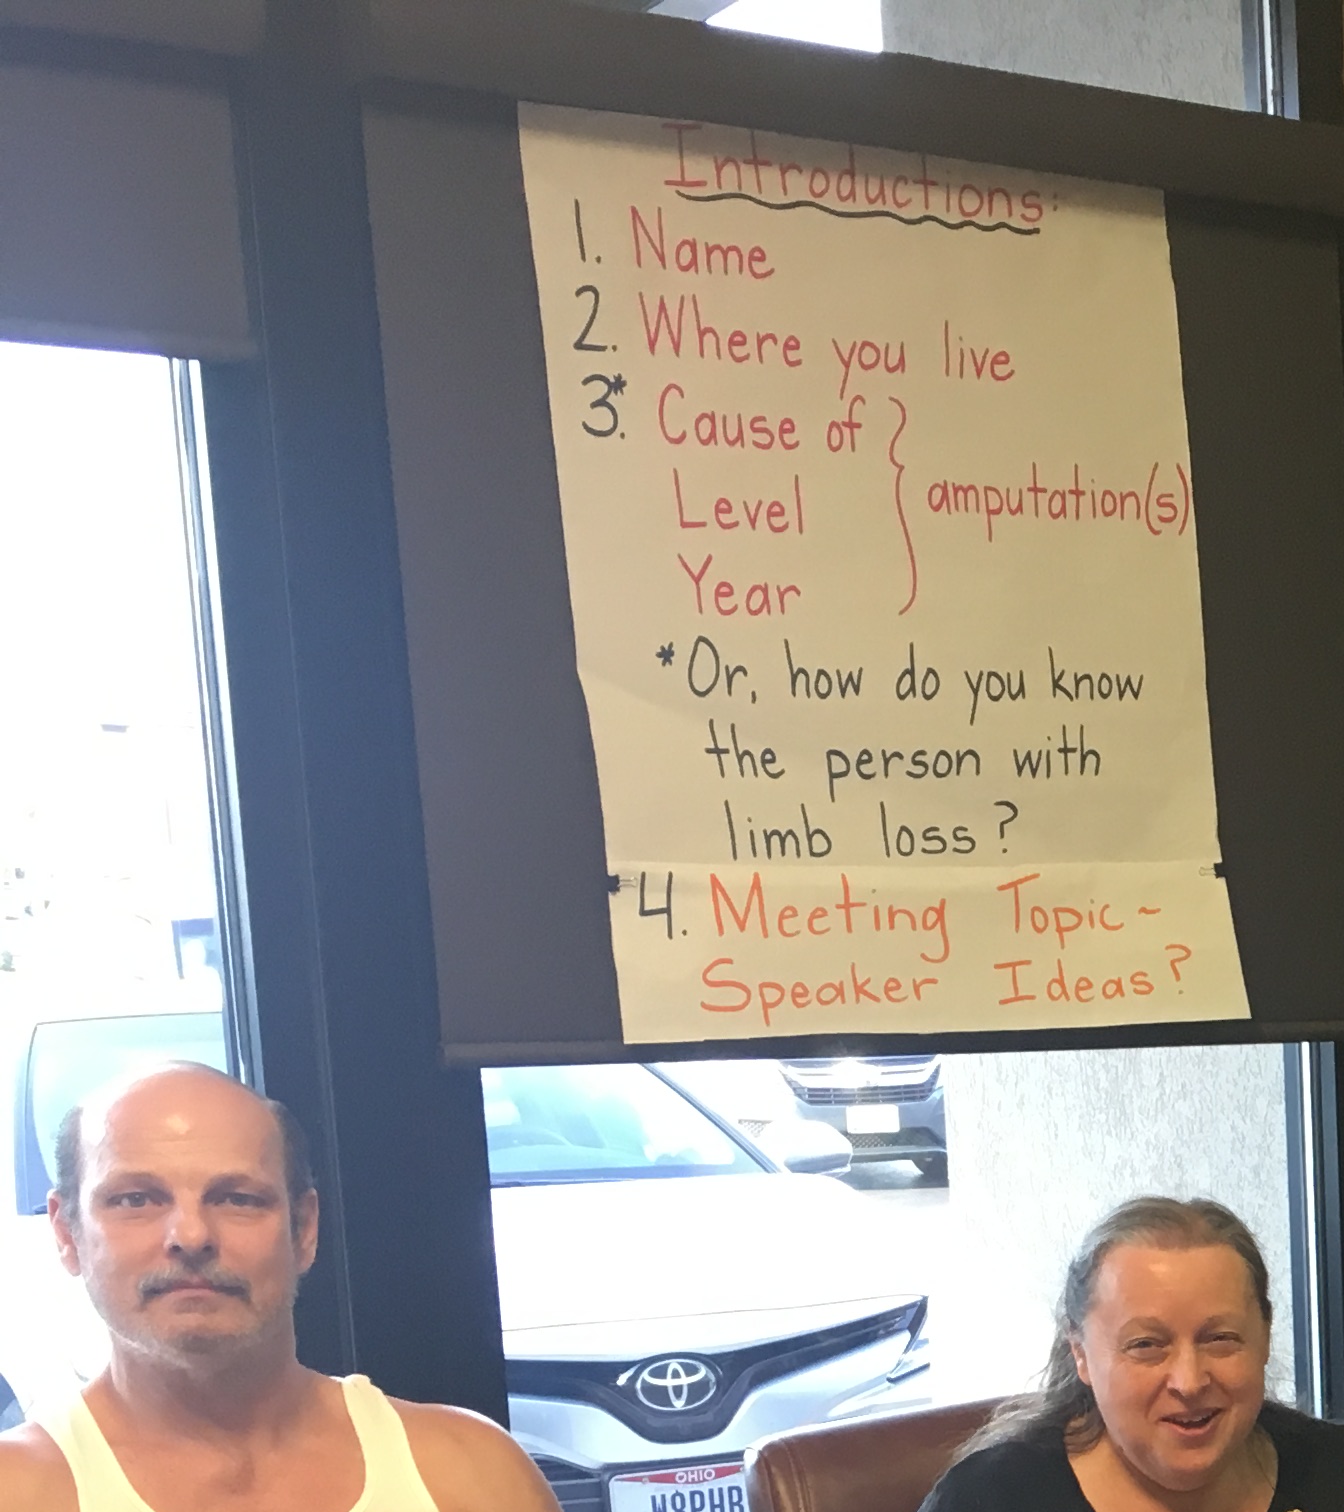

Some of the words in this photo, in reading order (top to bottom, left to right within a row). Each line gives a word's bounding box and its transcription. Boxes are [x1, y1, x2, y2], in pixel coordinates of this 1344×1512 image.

[663, 121, 1060, 226] Introductions:
[573, 199, 602, 264] 1.
[630, 204, 776, 281] Name
[573, 285, 618, 353] 2.
[639, 290, 803, 369] Where
[832, 336, 906, 399] you
[944, 319, 1016, 383] live
[657, 383, 801, 448] Cause
[826, 395, 866, 455] of
[673, 467, 804, 535] Level
[926, 461, 1191, 544] amputation(s)
[677, 553, 801, 617] Year
[784, 638, 864, 700] how
[895, 642, 941, 702] do
[964, 670, 1027, 726] you
[1047, 645, 1144, 703] know
[705, 718, 787, 781] the
[827, 741, 982, 803] person
[1012, 725, 1102, 778] with
[725, 798, 833, 861] limb
[637, 869, 688, 941] 4.
[709, 871, 950, 963] Meeting
[700, 957, 939, 1027] Speaker
[993, 943, 1193, 1008] Ideas?
[675, 1469, 716, 1484] OHIO
